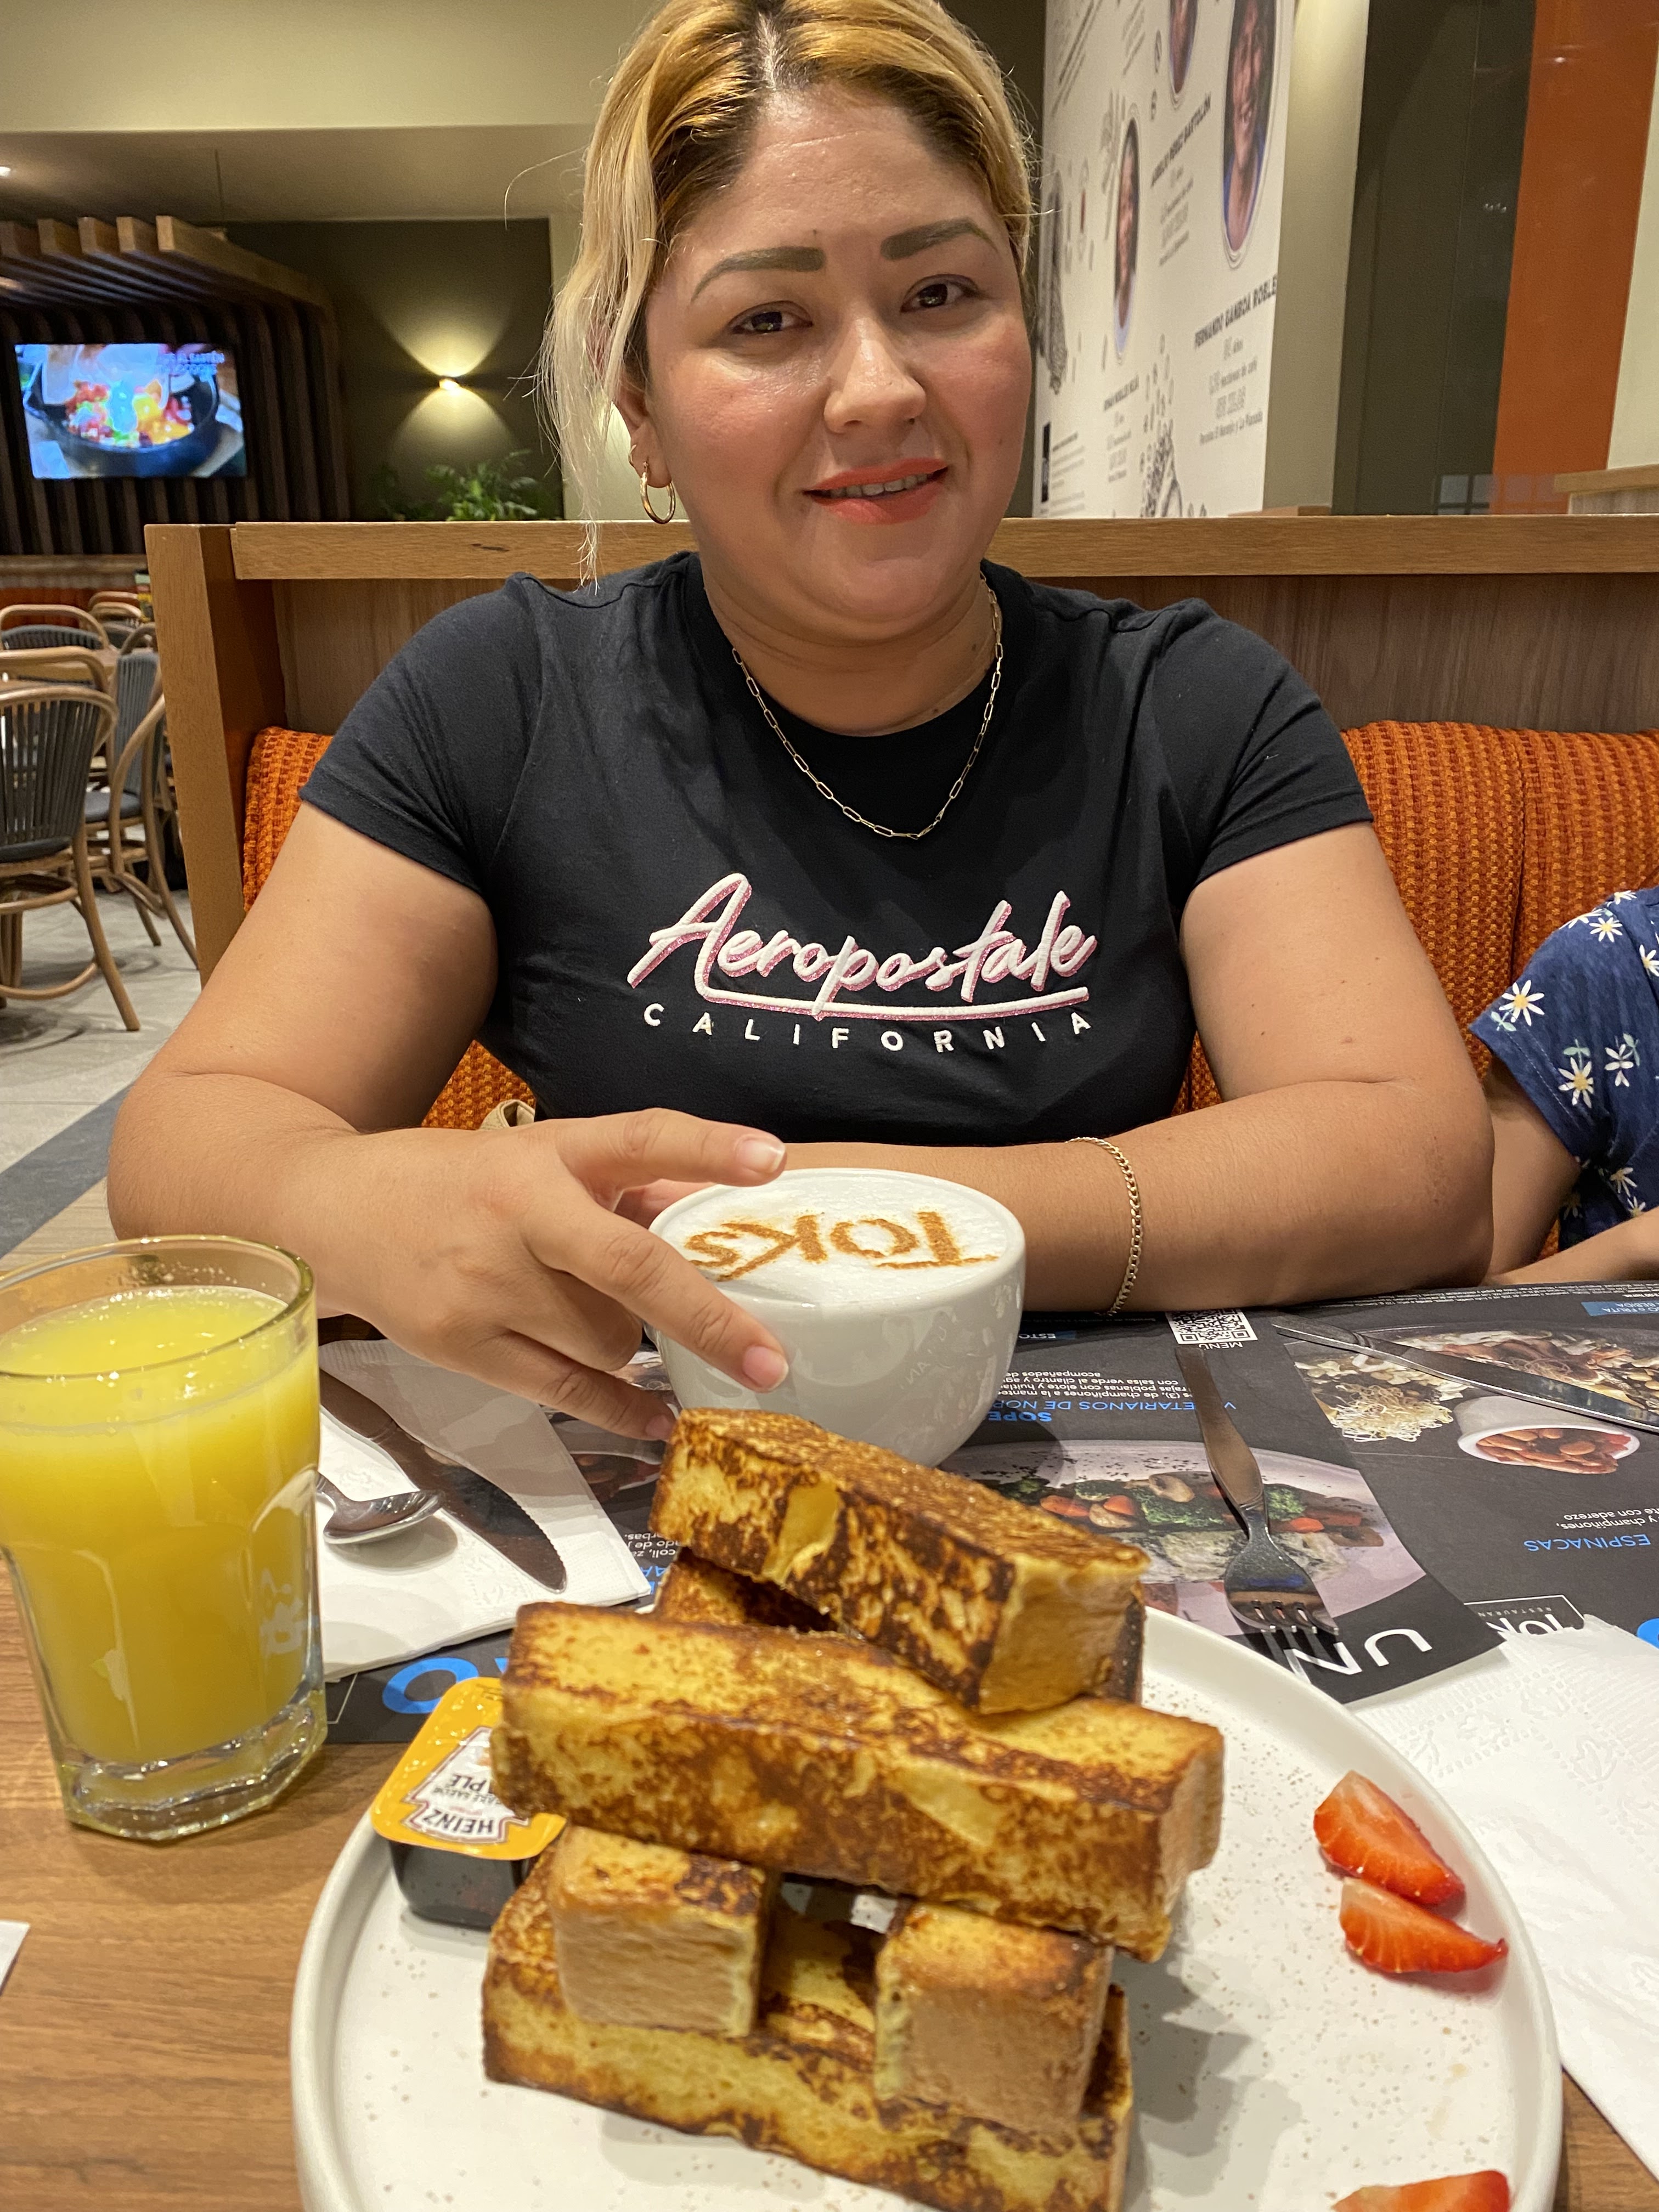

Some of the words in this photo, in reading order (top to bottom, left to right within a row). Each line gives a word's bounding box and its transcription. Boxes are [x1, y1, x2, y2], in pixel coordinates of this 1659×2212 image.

[627, 872, 1097, 1021] Aeropostale
[644, 1003, 1091, 1053] CALIFORNIA
[685, 1209, 998, 1282] TOKS
[1199, 1341, 1243, 1350] MENÚ
[1064, 1390, 1141, 1398] champiñones
[1043, 1401, 1071, 1409] DE
[1080, 1400, 1236, 1410] VETARIANOS
[988, 1411, 1052, 1422] SOPE
[1563, 1511, 1615, 1521] aderezo
[1648, 1515, 1657, 1523] y
[1556, 1517, 1646, 1529] champiñones,
[634, 1541, 652, 1550] de
[1523, 1534, 1651, 1551] ESPINACAS
[422, 1809, 494, 1835] HEINZ
